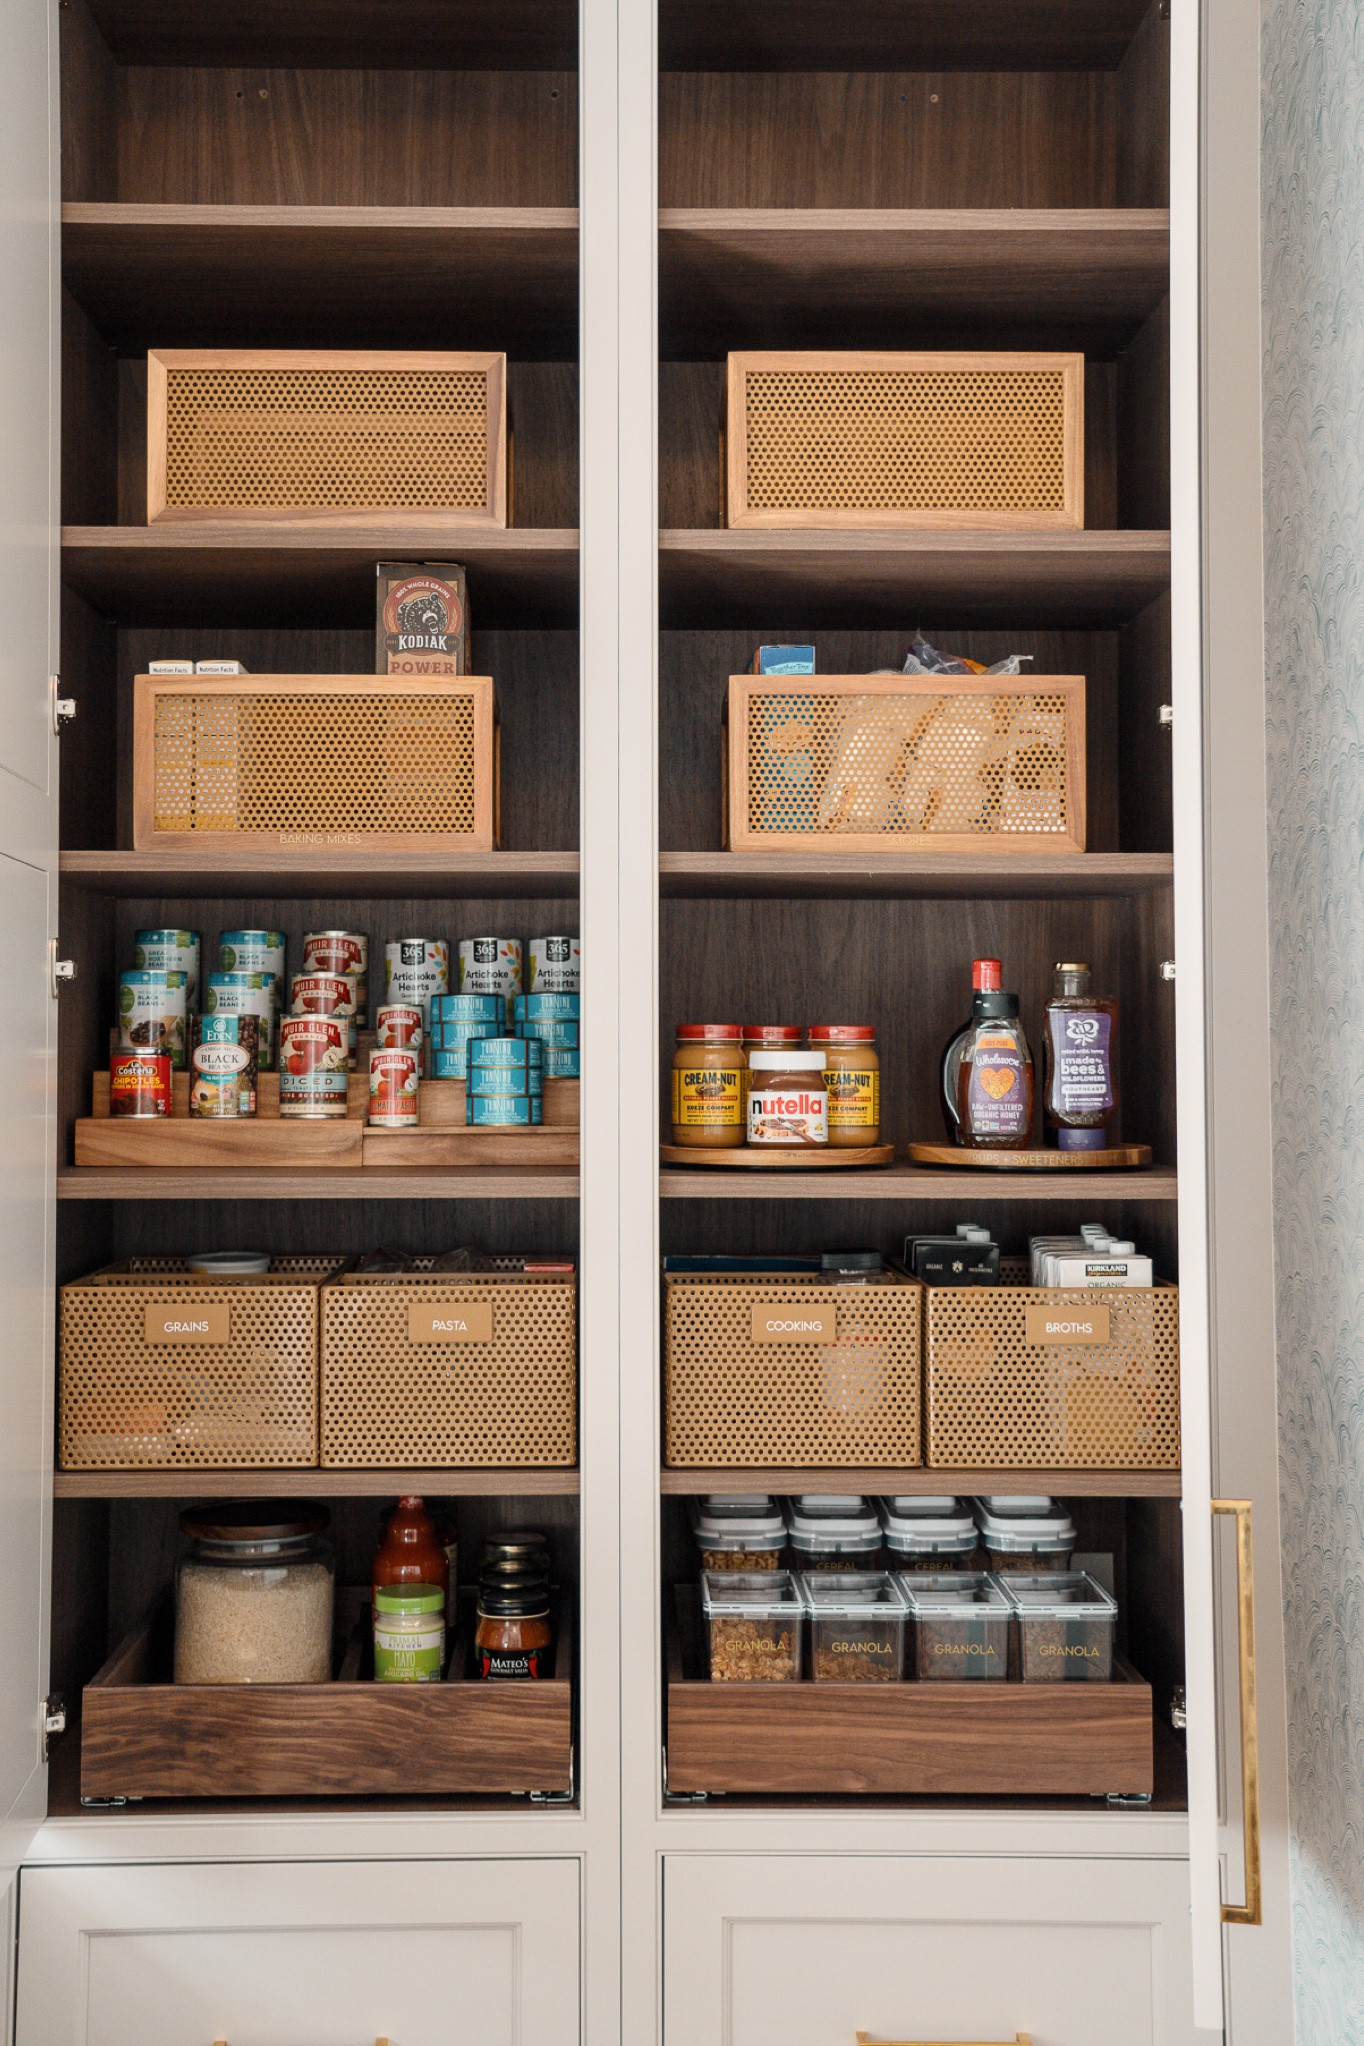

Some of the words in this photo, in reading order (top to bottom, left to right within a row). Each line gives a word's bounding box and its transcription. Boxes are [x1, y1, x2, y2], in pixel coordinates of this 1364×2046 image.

[407, 581, 430, 589] WHOLE
[430, 582, 451, 599] GRAINS
[398, 635, 448, 650] KODIAK
[390, 662, 454, 674] POWER
[280, 834, 324, 844] BAKING
[328, 834, 362, 844] MIXES
[307, 940, 328, 952] MUIR
[332, 940, 355, 952] GLEN
[475, 944, 495, 956] 365
[548, 944, 568, 954] 365
[402, 946, 422, 958] 365
[392, 972, 436, 980] Artichoke
[466, 970, 508, 978] Artichoke
[294, 980, 314, 993] MUIR
[320, 980, 344, 994] GLEN
[398, 982, 430, 991] Hearts
[472, 980, 502, 989] Hearts
[544, 979, 574, 988] Hearts
[208, 1030, 232, 1040] EDEN
[284, 1023, 304, 1036] MUIR
[308, 1023, 335, 1036] GLEN
[201, 1054, 240, 1064] BLACK
[1066, 1056, 1094, 1064] made
[1061, 1058, 1096, 1074] bees
[1097, 1064, 1105, 1074] &
[684, 1072, 736, 1086] CREAM-NUT
[824, 1074, 870, 1088] REAM-NUT
[752, 1094, 822, 1114] nutella
[1000, 1111, 1020, 1119] HONEY
[961, 1154, 1000, 1164] YRUPS
[1011, 1154, 1084, 1165] SWEETENERS
[164, 1320, 209, 1332] GRAINS
[432, 1320, 467, 1331] PASTA
[766, 1320, 822, 1331] COOKING
[1046, 1322, 1093, 1334] BROTHS
[816, 1562, 857, 1571] CEREAL
[915, 1562, 954, 1571] CEREAL
[726, 1640, 786, 1650] GRANOLA
[831, 1642, 892, 1654] GRANOLA
[934, 1643, 995, 1655] GRANOLA
[1039, 1645, 1100, 1657] GRANOLA
[394, 1650, 415, 1667] MAYO
[491, 1657, 529, 1668] MATEO'S
